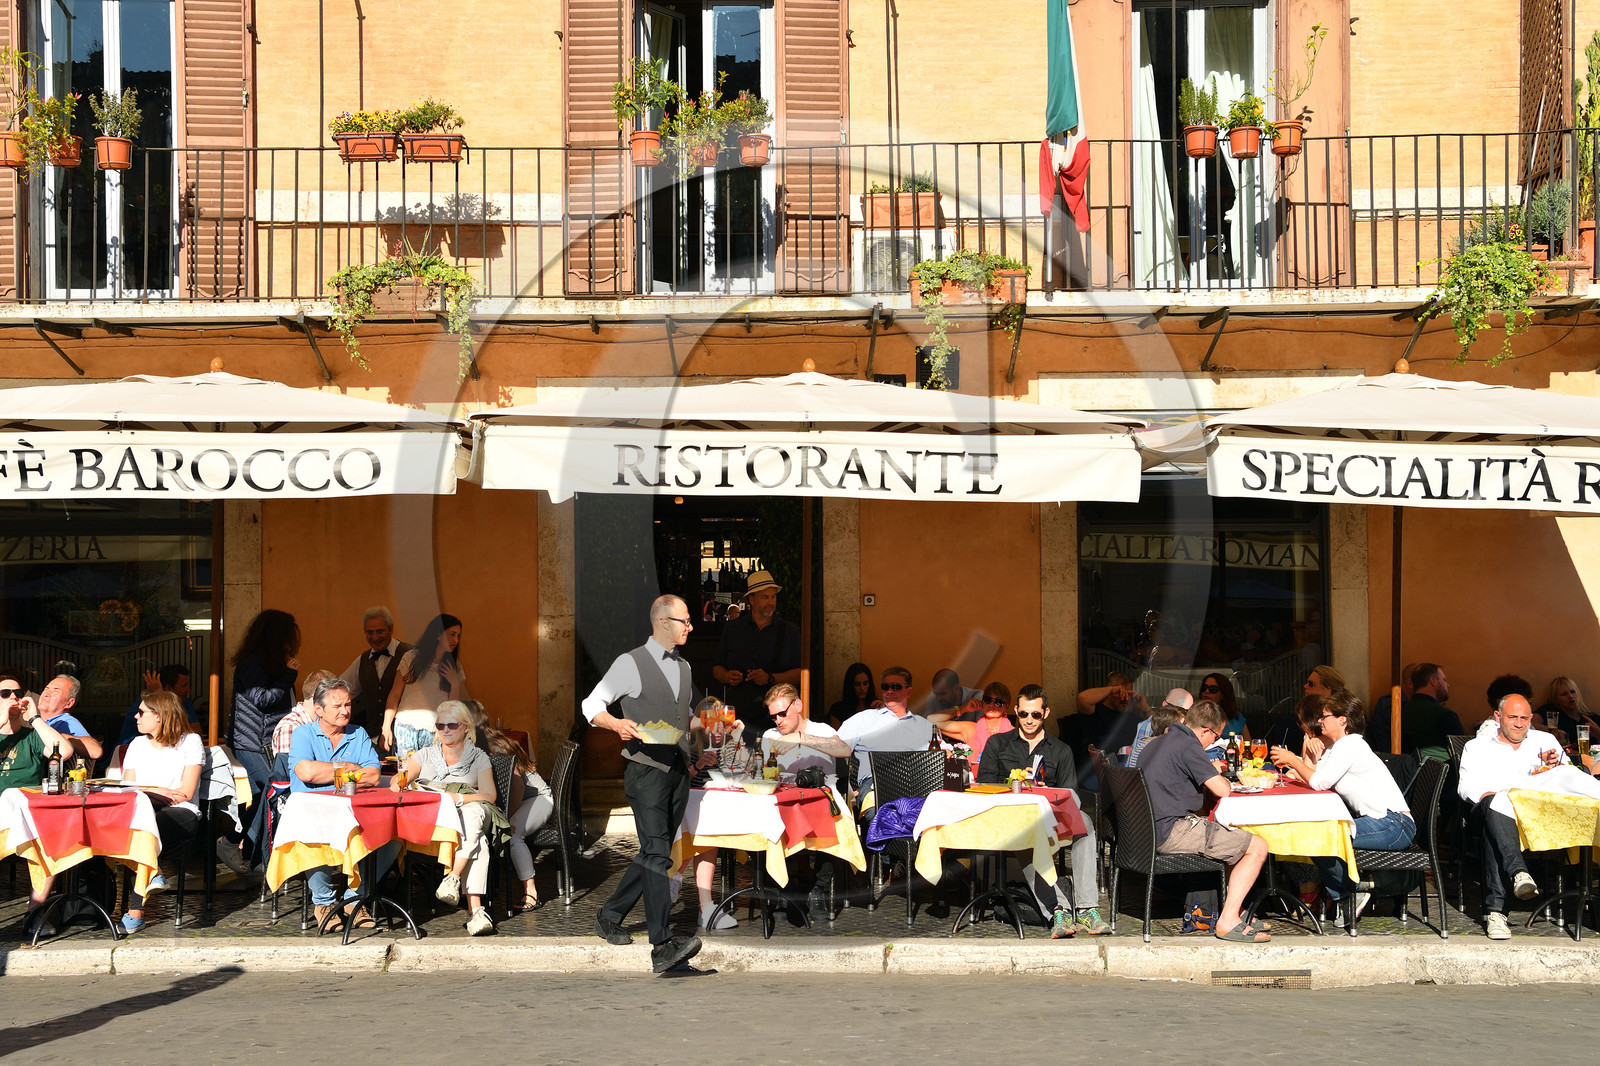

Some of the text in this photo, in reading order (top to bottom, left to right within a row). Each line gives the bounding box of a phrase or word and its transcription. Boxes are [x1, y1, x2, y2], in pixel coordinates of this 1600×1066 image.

[69, 447, 382, 492] BAROCCO
[613, 444, 1003, 495] RISTORANTE
[1242, 447, 1562, 504] SPECIALITÀ
